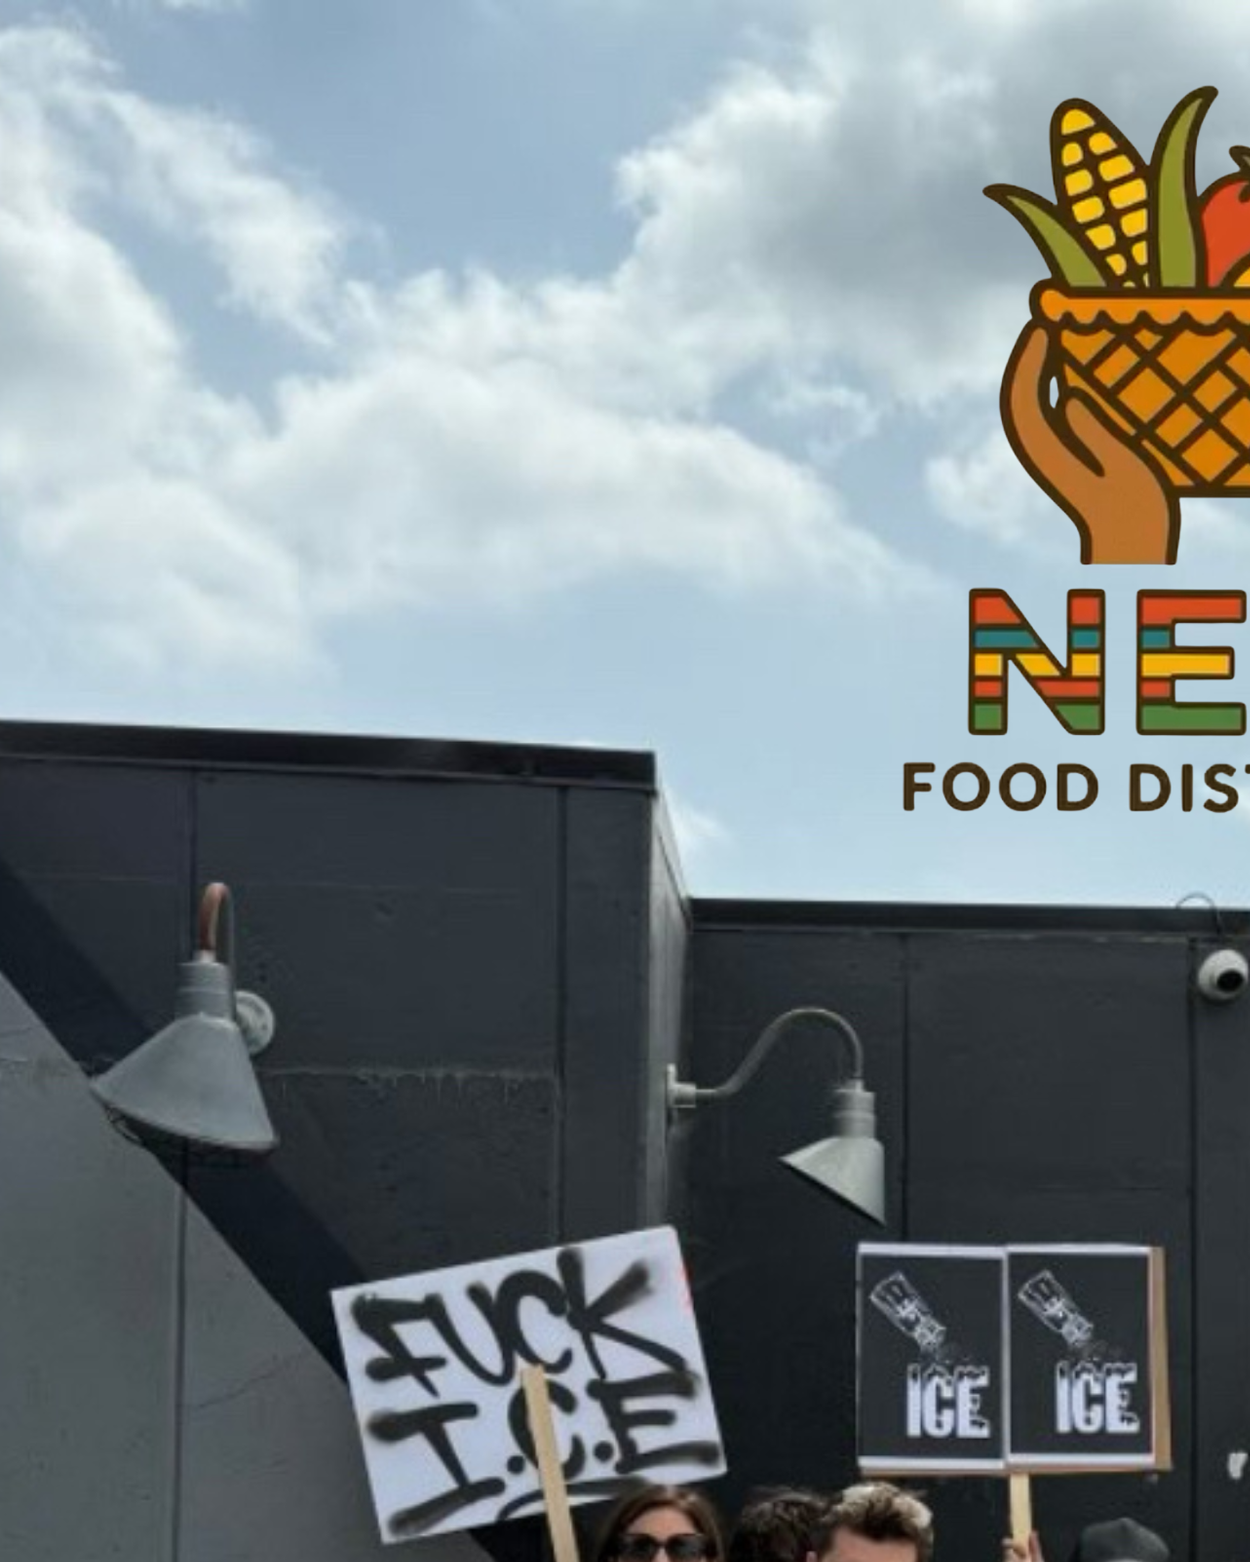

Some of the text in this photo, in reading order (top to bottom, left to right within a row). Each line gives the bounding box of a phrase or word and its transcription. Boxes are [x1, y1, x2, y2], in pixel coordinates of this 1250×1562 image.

[352, 1248, 688, 1398] FUCK
[906, 1363, 991, 1439] ICE
[1055, 1361, 1140, 1434] ICE
